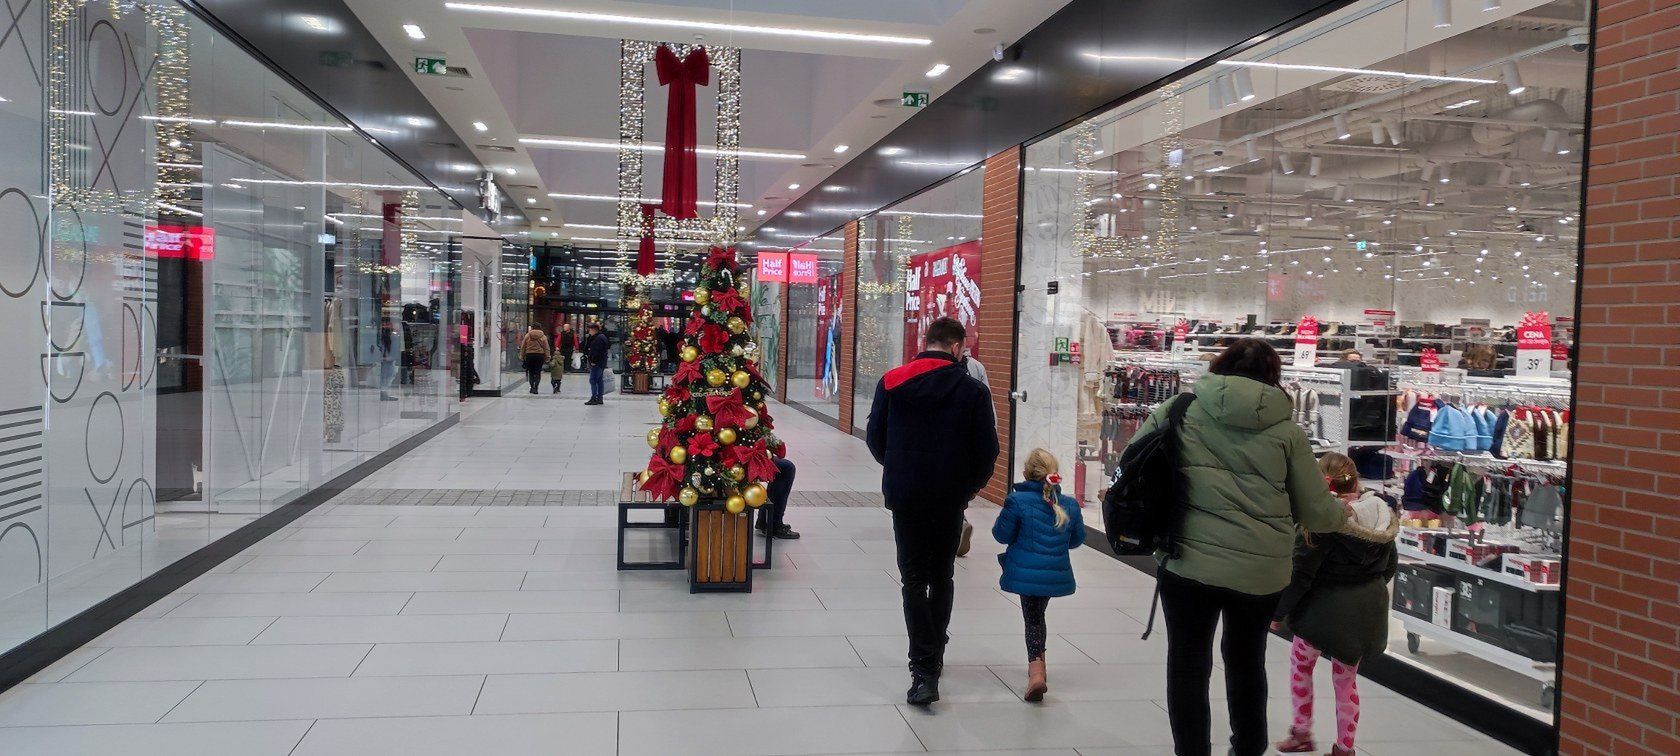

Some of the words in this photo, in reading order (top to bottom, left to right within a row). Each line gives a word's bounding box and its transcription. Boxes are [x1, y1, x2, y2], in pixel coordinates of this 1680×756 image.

[762, 258, 783, 268] Half
[762, 267, 783, 276] Price
[905, 266, 921, 291] Half
[905, 292, 921, 310] Price
[1523, 331, 1545, 339] CENA
[1527, 358, 1540, 370] 39
